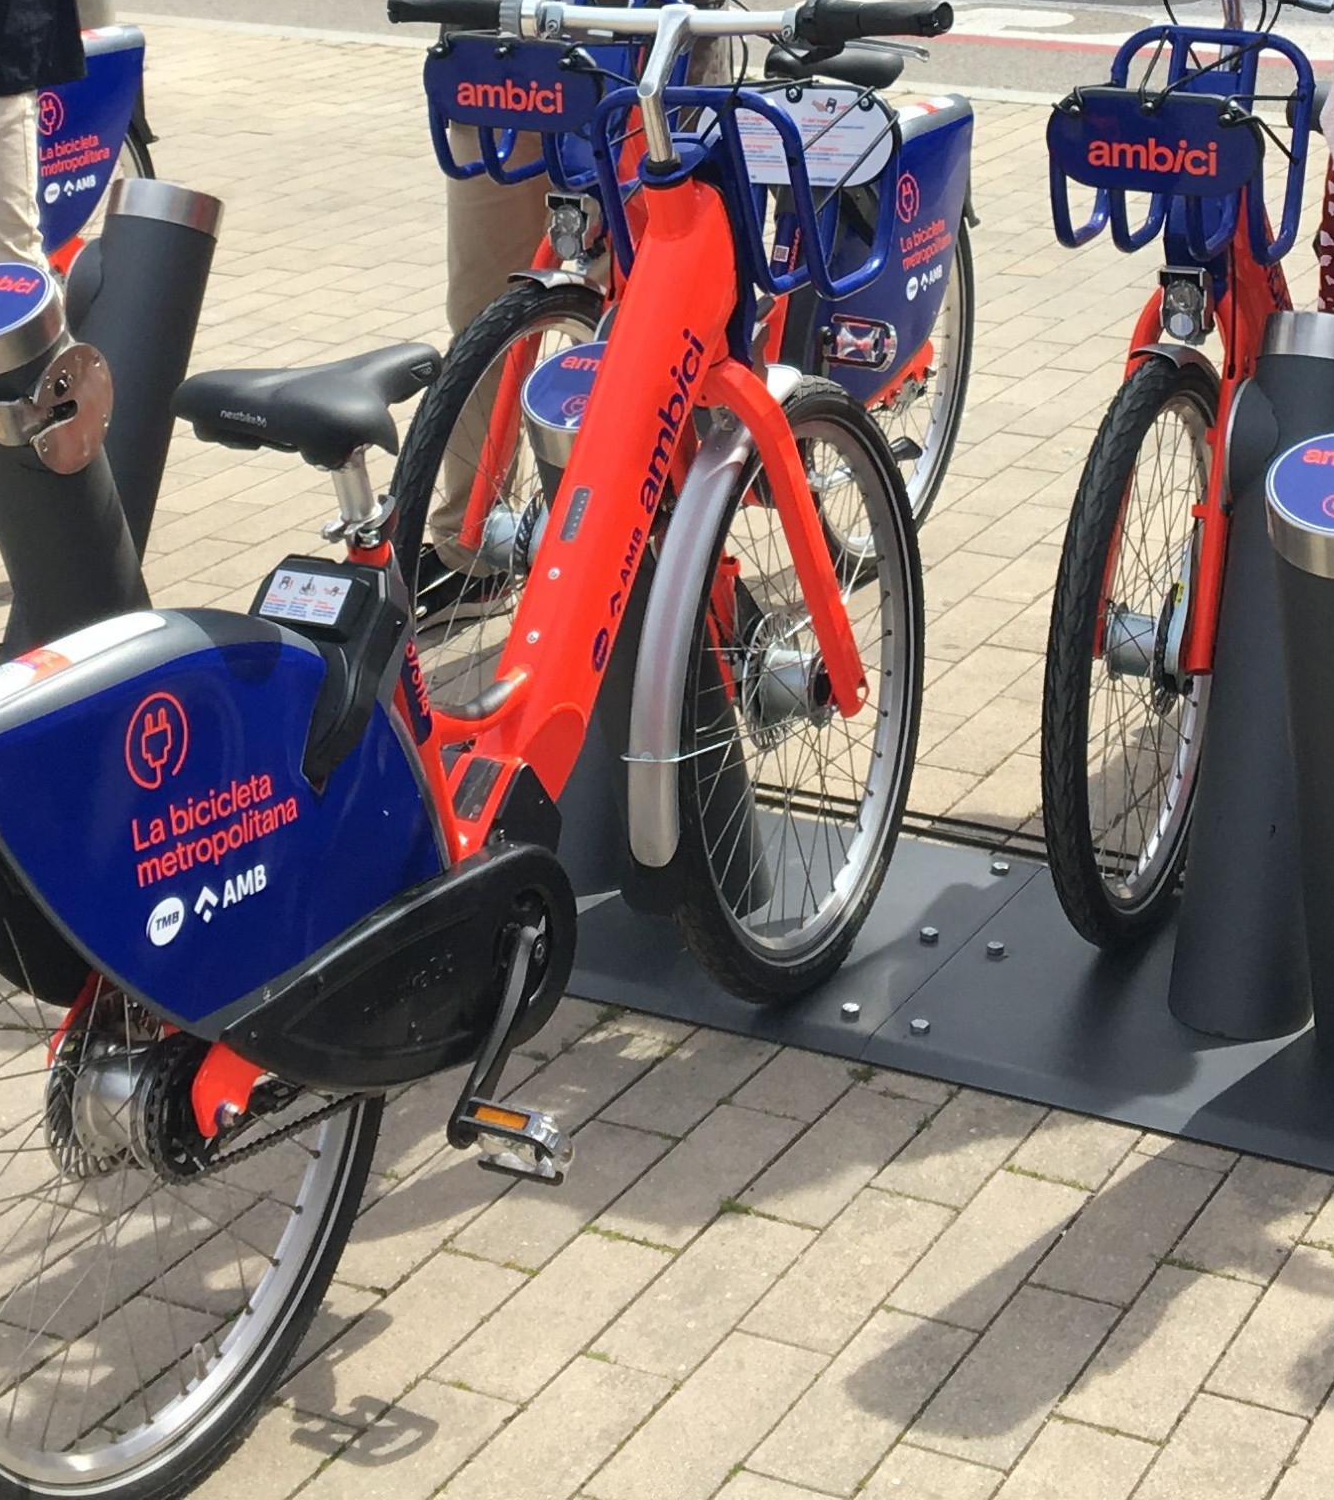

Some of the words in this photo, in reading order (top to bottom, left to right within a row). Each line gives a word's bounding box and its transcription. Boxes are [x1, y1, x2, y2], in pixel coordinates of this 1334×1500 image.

[457, 79, 563, 114] ambici
[39, 146, 53, 161] La
[55, 134, 99, 158] bicicleta
[1087, 138, 1217, 176] ambici
[640, 328, 705, 514] ambici
[620, 527, 643, 587] AMB
[132, 818, 166, 852] La
[169, 774, 273, 836] bicicleta
[137, 797, 299, 888] metropolitana
[155, 911, 180, 932] TMB
[222, 864, 267, 909] AMB
